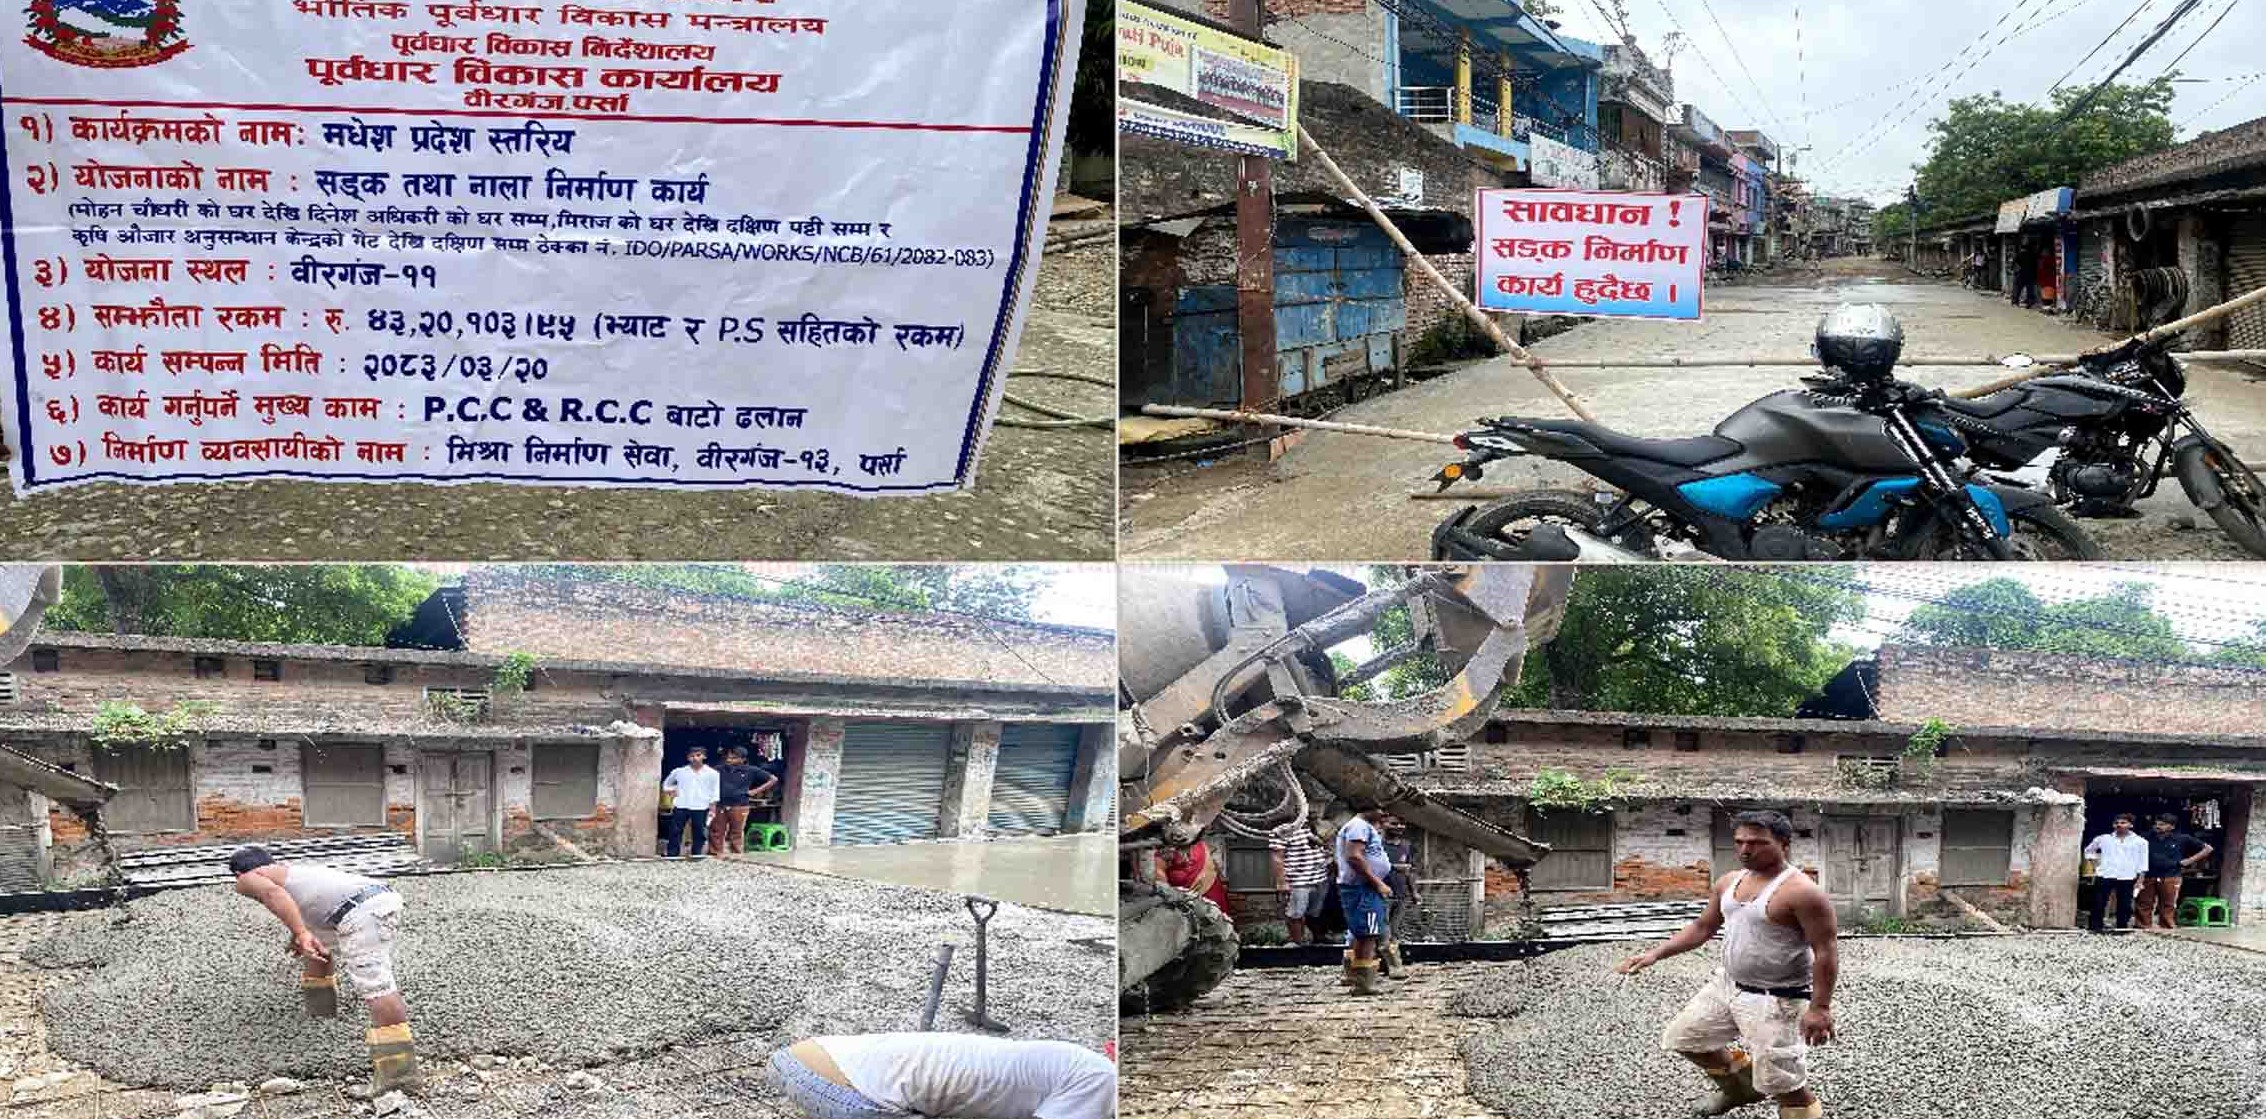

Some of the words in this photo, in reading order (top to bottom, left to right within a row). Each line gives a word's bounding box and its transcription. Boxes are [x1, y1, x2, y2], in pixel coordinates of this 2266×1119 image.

[557, 5, 671, 28] विकास
[686, 15, 828, 33] मन्त्रालय
[487, 32, 573, 57] विकास
[453, 57, 587, 88] विकास
[600, 66, 782, 93] कार्यालय
[69, 110, 225, 145] कार्यक्रमको
[322, 117, 397, 152] मधेश
[410, 120, 475, 154] प्रदेश
[71, 159, 204, 189] योजनाको
[216, 169, 272, 192] नाम
[402, 174, 457, 197] तथा
[468, 176, 533, 201] नाला
[545, 167, 638, 201] निर्माण
[650, 173, 709, 204] कार्य
[197, 199, 221, 218] को
[227, 206, 255, 218] घर
[262, 200, 300, 222] देखि
[307, 202, 359, 223] दिनेश
[446, 206, 470, 225] को
[477, 213, 504, 225] घर
[618, 210, 642, 230] को
[649, 218, 677, 231] घर
[682, 211, 719, 234] देखि
[727, 214, 781, 235] दक्षिण
[831, 222, 871, 235] सम्म
[879, 223, 891, 237] र
[1504, 201, 1650, 225] सावधान
[72, 225, 108, 247] कृषि
[117, 223, 175, 243] औजार
[352, 228, 380, 248] गेट
[389, 230, 425, 250] देखि
[431, 232, 485, 253] दक्षिण
[1584, 236, 1687, 264] निर्माण
[84, 253, 173, 281] योजना
[186, 260, 250, 285] स्थल
[1498, 272, 1563, 295] कार्य
[213, 306, 286, 332] रकम
[683, 318, 705, 344] र
[719, 317, 764, 343] P.S
[777, 312, 882, 348] सहितको
[91, 344, 147, 373] कार्य
[161, 351, 247, 375] सम्पन्न
[260, 343, 322, 374] मिति
[97, 390, 149, 418] कार्य
[253, 395, 313, 425] मुख्य
[323, 398, 382, 419] काम
[425, 397, 512, 421] P.C.C
[523, 398, 549, 421] &
[560, 398, 652, 425] R.C.C
[667, 400, 725, 428] बाटो
[736, 407, 808, 429] ढलान
[101, 432, 189, 463] निर्माण
[357, 442, 407, 463] नाम
[446, 435, 513, 463] मिश्रा
[524, 435, 612, 465] निर्माण
[859, 447, 907, 476] पर्सा
